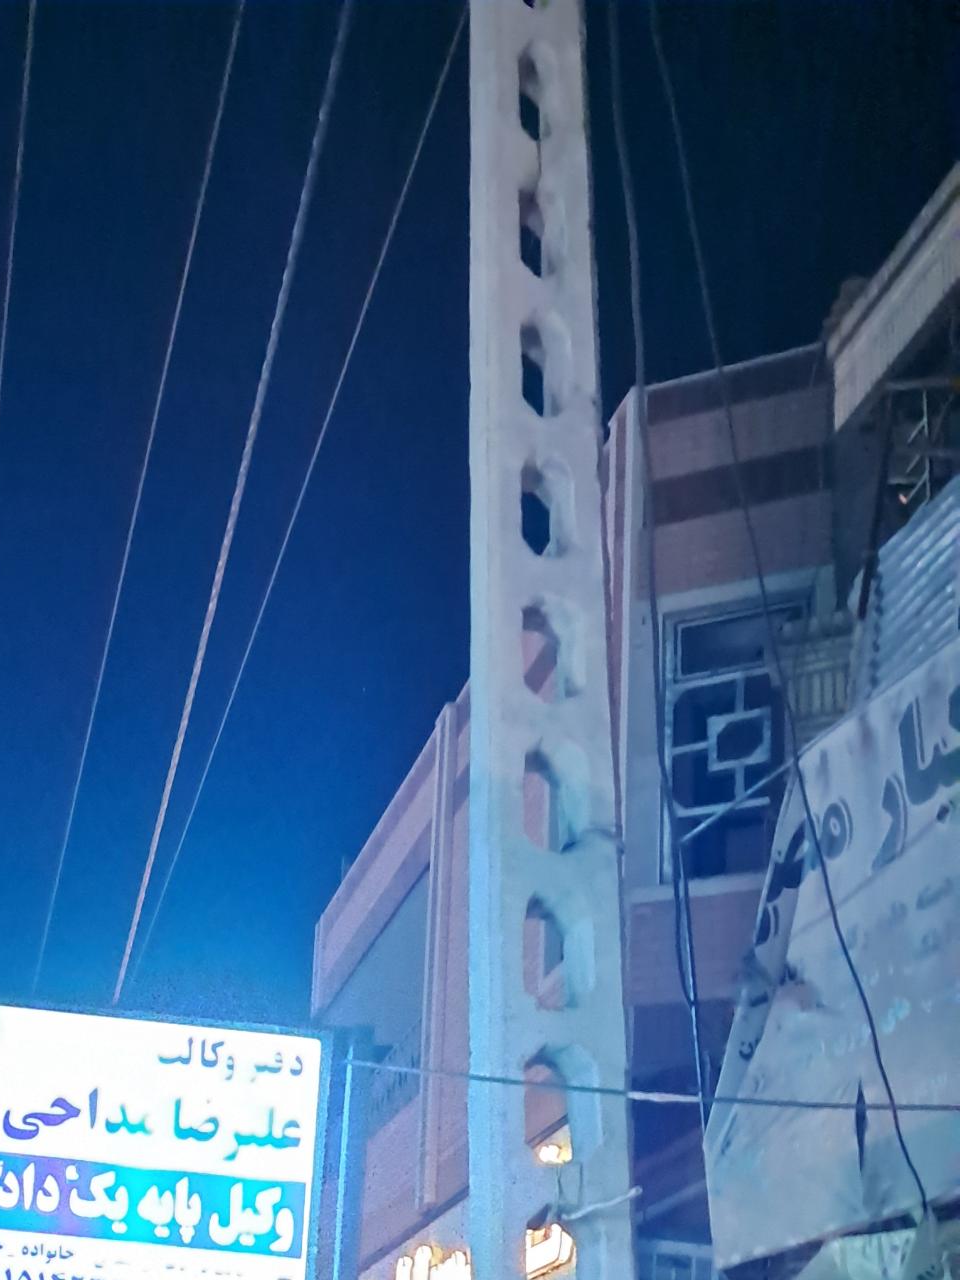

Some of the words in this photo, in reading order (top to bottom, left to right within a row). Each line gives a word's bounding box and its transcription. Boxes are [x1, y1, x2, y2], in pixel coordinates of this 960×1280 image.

[67, 1167, 129, 1234] یک
[136, 1176, 201, 1244] پایه
[209, 1182, 295, 1253] وکیل
